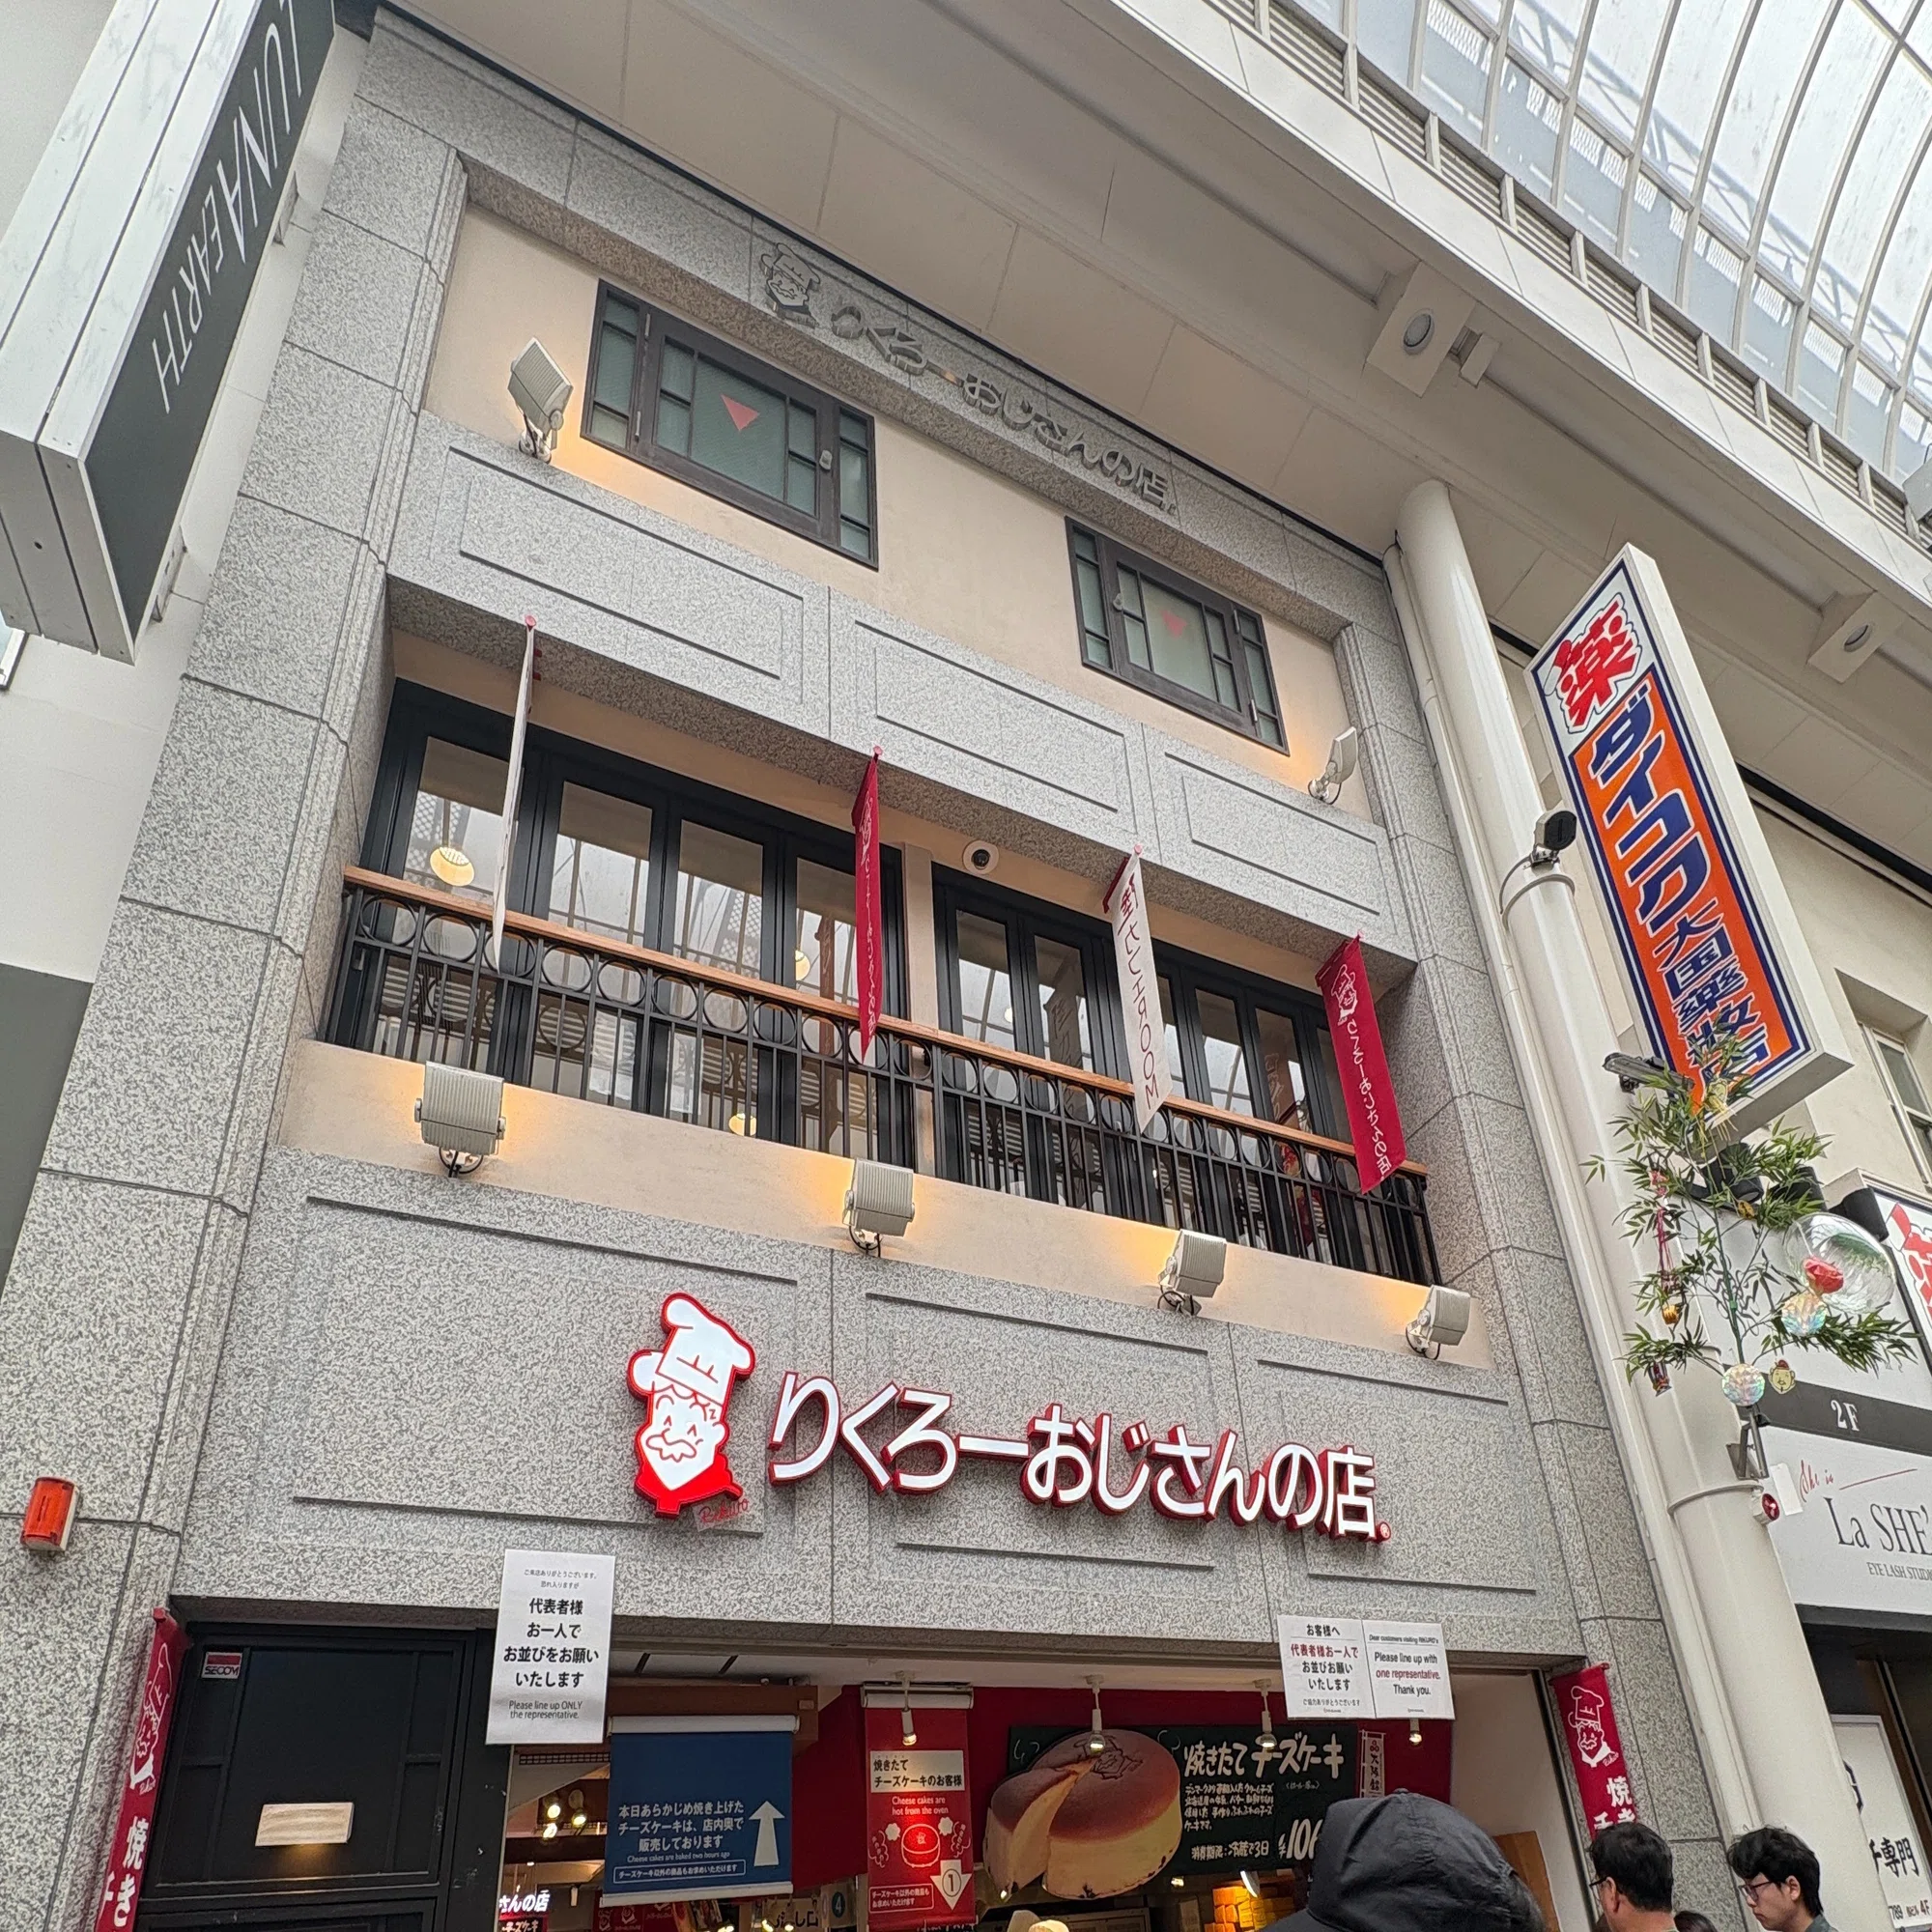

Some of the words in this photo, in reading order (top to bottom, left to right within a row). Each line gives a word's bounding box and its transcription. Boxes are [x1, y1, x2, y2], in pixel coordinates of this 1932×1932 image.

[153, 185, 224, 413] EARTH
[1557, 600, 1642, 728] 薬
[1589, 680, 1710, 935] ダイコク
[1831, 1400, 1860, 1432] 2F
[769, 1371, 1377, 1538] りくろーおじさんの店
[1824, 1497, 1869, 1548] La
[1866, 1562, 1885, 1576] EYE
[1884, 1563, 1907, 1578] LASH
[529, 1598, 583, 1615] 代表者様
[526, 1622, 582, 1638] お一人で
[1306, 1624, 1341, 1636] お客様へ
[503, 1646, 599, 1663] お並びをお願い
[1291, 1644, 1359, 1659] 代表者様お一人で
[1375, 1652, 1398, 1662] Please
[1399, 1653, 1412, 1662] line
[1413, 1656, 1422, 1665] up
[1423, 1654, 1437, 1663] with
[204, 1665, 240, 1675] SECOM
[1302, 1661, 1353, 1674] お並びお願い
[1376, 1669, 1390, 1678] one
[1391, 1669, 1440, 1681] representative.
[516, 1671, 583, 1688] いたします
[1308, 1678, 1350, 1690] いたします
[1393, 1684, 1415, 1694] Thank
[1416, 1687, 1431, 1697] you.
[509, 1700, 532, 1710] Please
[534, 1700, 549, 1710] line
[550, 1702, 560, 1711] up
[561, 1700, 582, 1710] ONLY
[510, 1710, 523, 1719] the
[525, 1710, 580, 1720] representative.
[1183, 1740, 1248, 1777] 焼きたて
[1251, 1732, 1344, 1779] チーズケーキ
[873, 1759, 909, 1772] 焼きたて
[874, 1775, 963, 1788] チーズケーキのお客様
[892, 1796, 916, 1805] Cheese
[917, 1796, 934, 1804] cakes
[618, 1800, 744, 1819] 本日あらかじめ焼き上げた
[892, 1806, 903, 1815] hot
[618, 1817, 744, 1836] チーズケーキは、店内奥で
[638, 1834, 724, 1852] 販売しております
